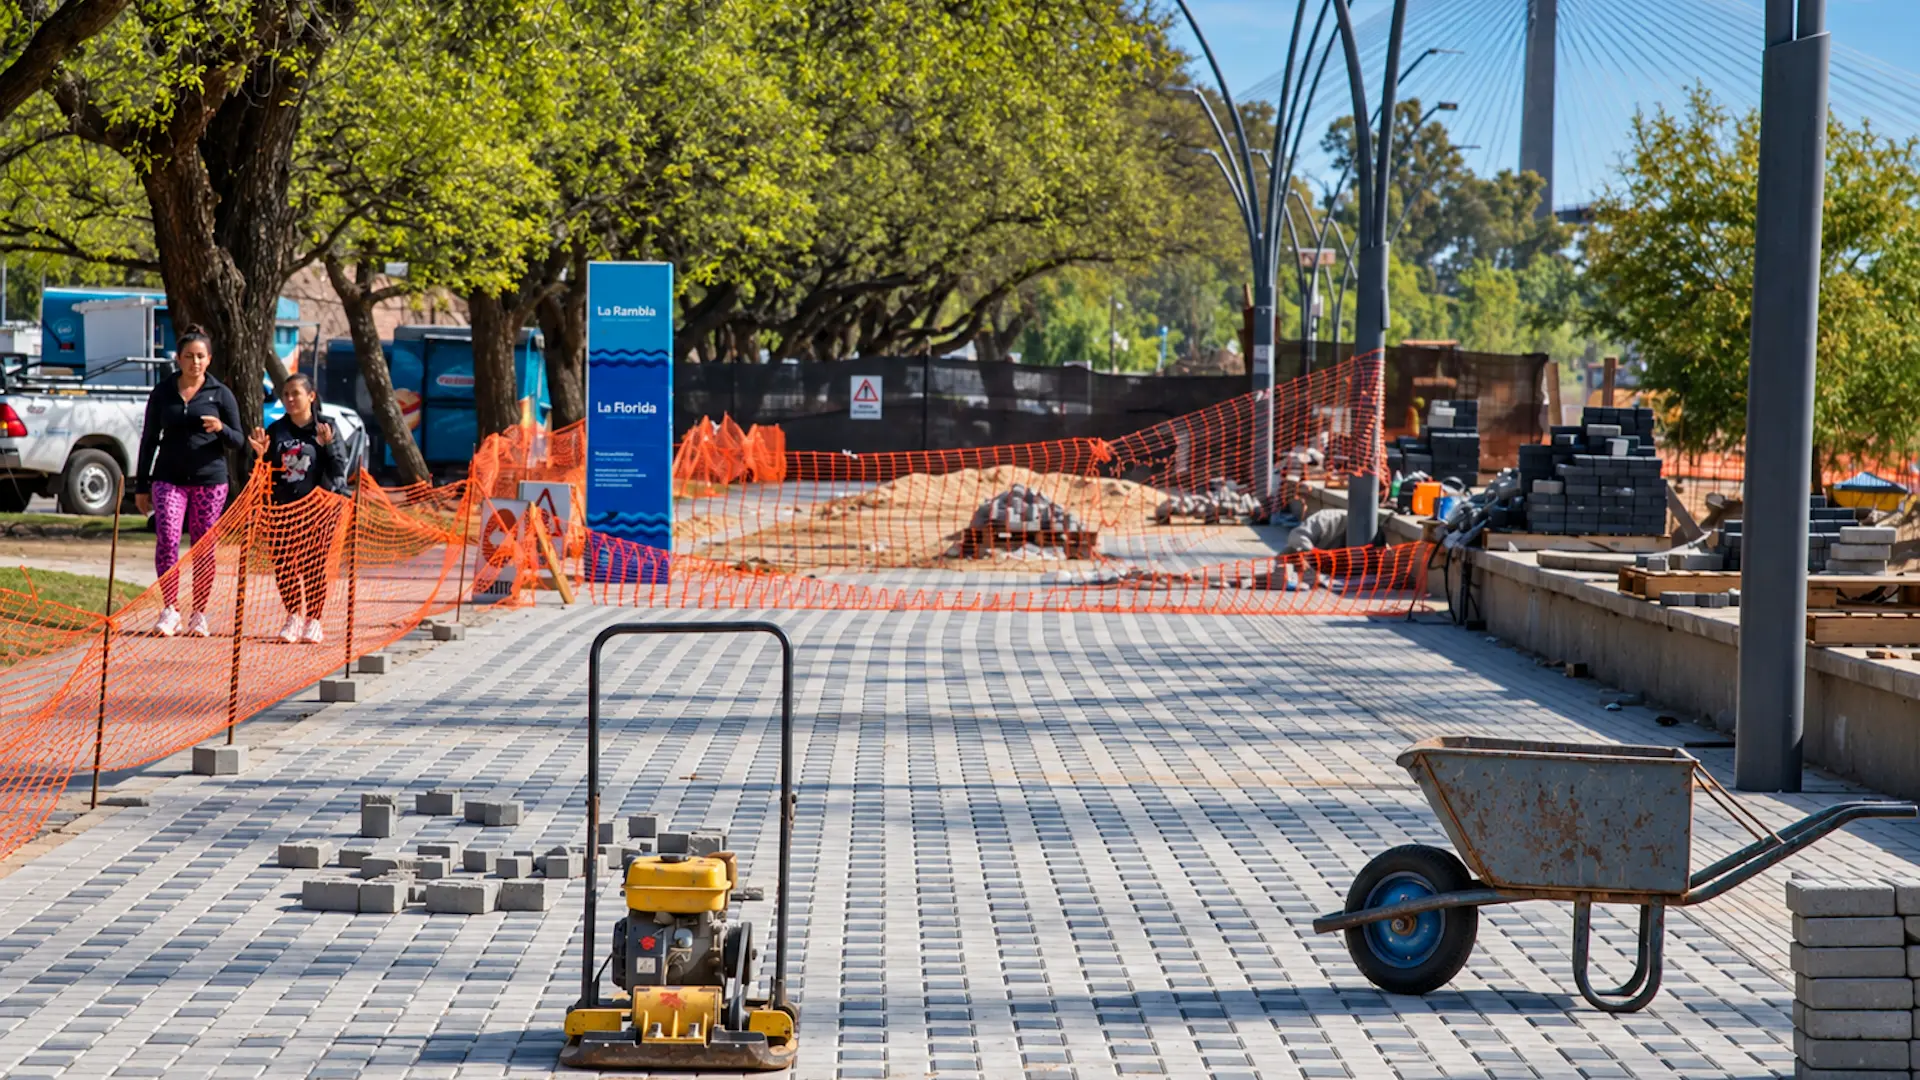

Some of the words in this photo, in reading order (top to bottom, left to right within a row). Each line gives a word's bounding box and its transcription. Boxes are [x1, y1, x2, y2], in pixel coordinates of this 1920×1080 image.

[597, 305, 611, 316] La
[613, 305, 656, 316] Rambla
[597, 401, 611, 413] La
[614, 401, 656, 414] Florida
